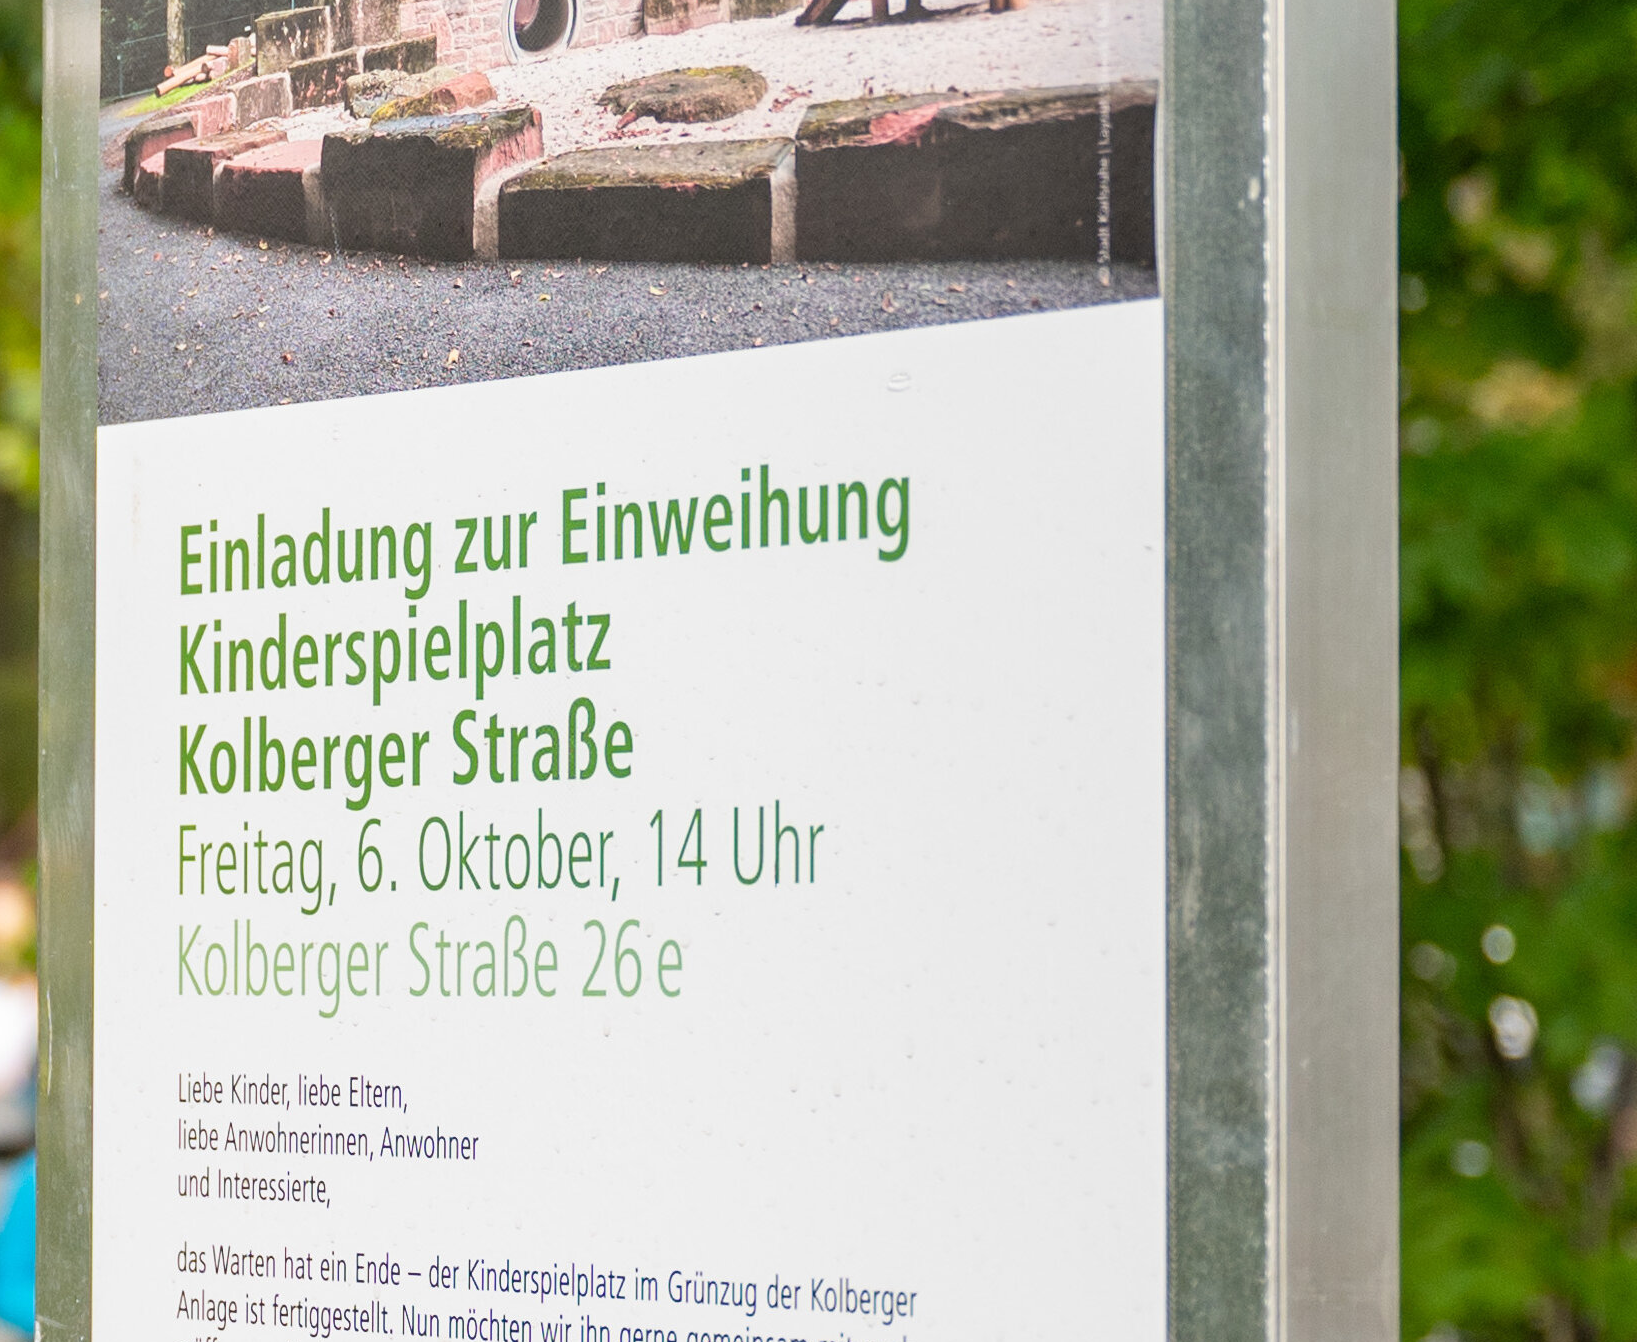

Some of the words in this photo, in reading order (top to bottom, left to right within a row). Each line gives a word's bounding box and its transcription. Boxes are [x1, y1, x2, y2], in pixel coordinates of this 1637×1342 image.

[180, 506, 432, 601] Einladung
[454, 511, 538, 574] zur
[561, 463, 910, 565] Einweihung
[179, 594, 612, 707] Kinderspielplatz
[179, 715, 430, 812] Kolberger
[452, 696, 634, 786] Straße
[178, 821, 337, 916] Freitag,
[357, 817, 397, 893] 6.
[418, 807, 620, 902] Oktober,
[649, 808, 708, 887] 14
[733, 799, 825, 887] Uhr
[178, 918, 389, 1019] Kolberger
[409, 914, 558, 998] Straße
[178, 1071, 224, 1104] Liebe
[231, 1073, 290, 1111] Kinder,
[298, 1073, 341, 1107] liebe
[349, 1074, 408, 1114] Eltern,
[178, 1118, 219, 1151] liebe
[224, 1121, 374, 1162] Anwohnerinnen,
[379, 1125, 479, 1161] Anwohner
[178, 1166, 210, 1198] und
[218, 1168, 331, 1209] Interessierte,
[176, 1289, 238, 1331] Anlage
[245, 1293, 266, 1326] ist
[272, 1293, 393, 1339] fertiggestellt.
[402, 1304, 440, 1338] Nun
[177, 1241, 207, 1274] das
[212, 1244, 276, 1278] Warten
[284, 1246, 313, 1281] hat
[320, 1250, 347, 1283] ein
[355, 1252, 401, 1286] Ende
[428, 1255, 460, 1290] der
[467, 1258, 626, 1307] Kinderspielplatz
[635, 1267, 658, 1302] im
[667, 1270, 757, 1318] Grünzug
[766, 1274, 802, 1310] der
[811, 1278, 918, 1326] Kolberger
